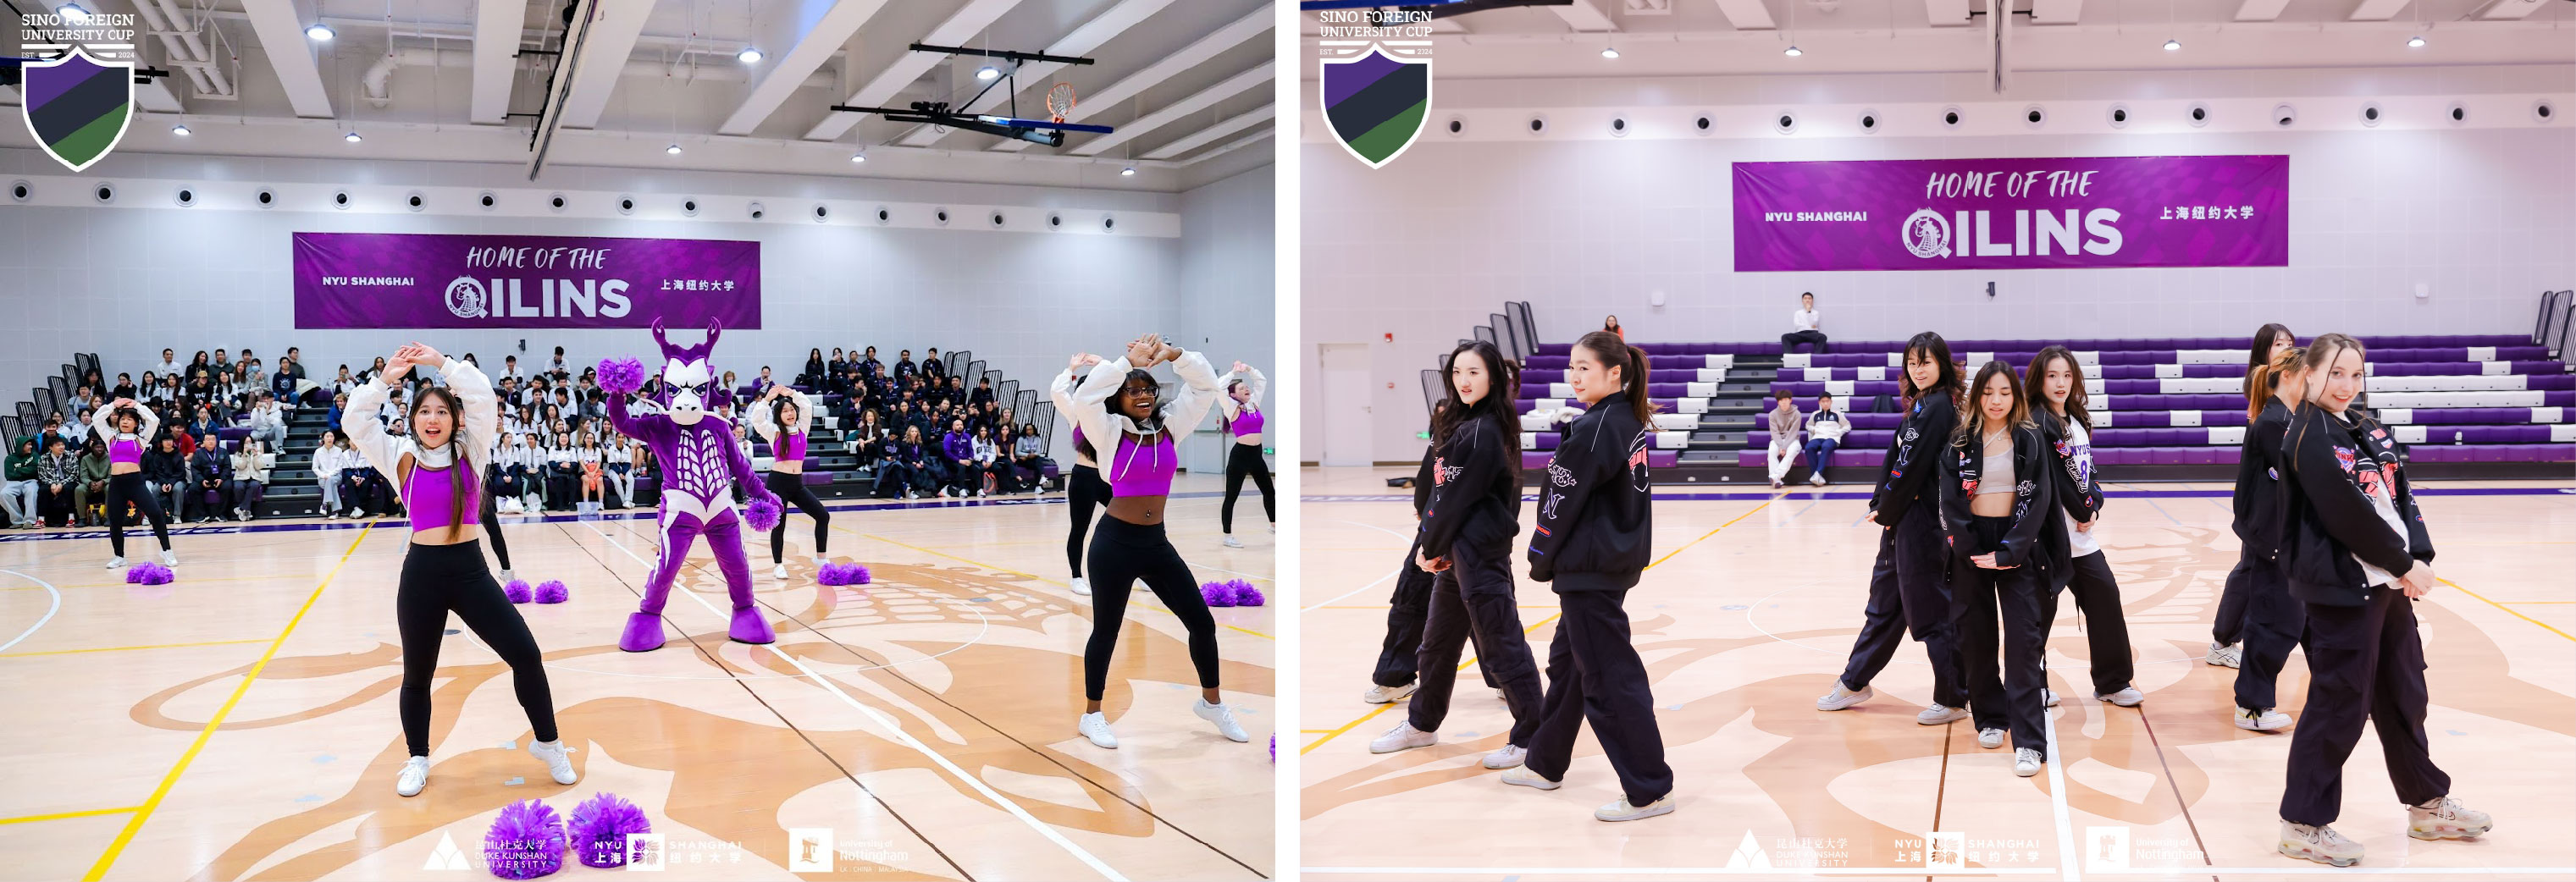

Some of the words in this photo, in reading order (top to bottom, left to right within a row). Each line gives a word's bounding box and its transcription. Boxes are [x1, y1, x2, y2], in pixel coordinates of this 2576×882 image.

[1926, 171, 2004, 200] HOME
[2007, 170, 2046, 198] OF
[2045, 170, 2099, 198] THE
[1765, 212, 1794, 222] NYU
[1796, 211, 1867, 222] SHANGHAI
[2159, 205, 2254, 220] 上海纽约大学
[1902, 207, 2123, 259] QILINS
[467, 245, 532, 269] HOME
[533, 246, 568, 269] OF
[567, 246, 611, 270] THE
[322, 276, 348, 286] NYU
[351, 276, 414, 286] SHANGHAI
[661, 278, 734, 292] 上海纽约大学
[445, 274, 632, 319] QILINS
[2081, 460, 2088, 483] 8
